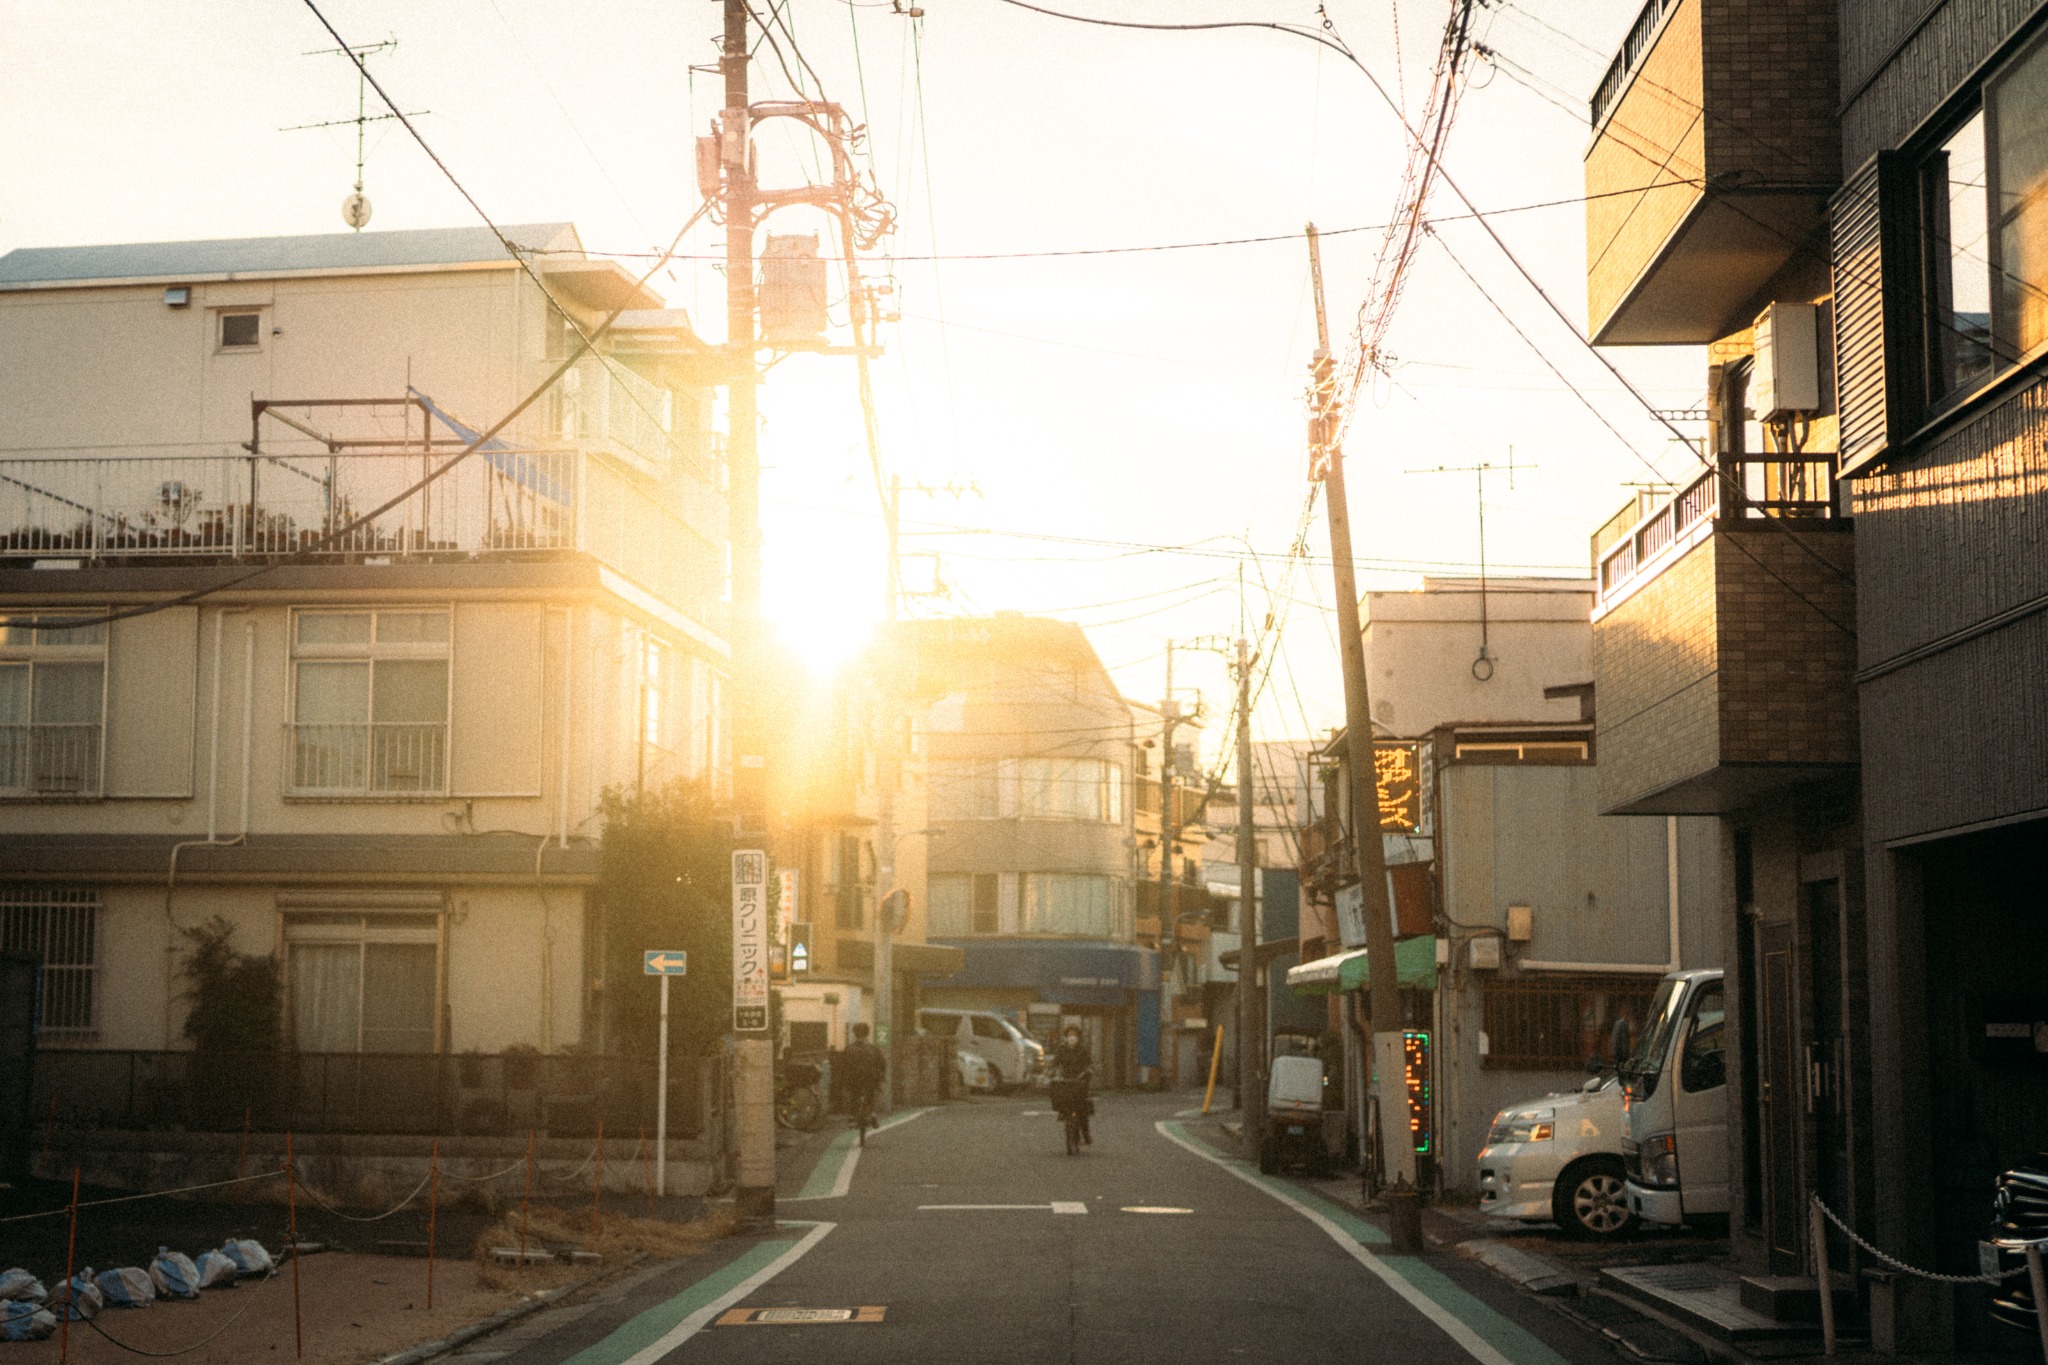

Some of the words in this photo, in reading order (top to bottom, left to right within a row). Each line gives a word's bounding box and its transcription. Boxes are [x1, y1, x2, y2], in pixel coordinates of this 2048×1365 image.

[740, 887, 758, 975] 原クリニック
